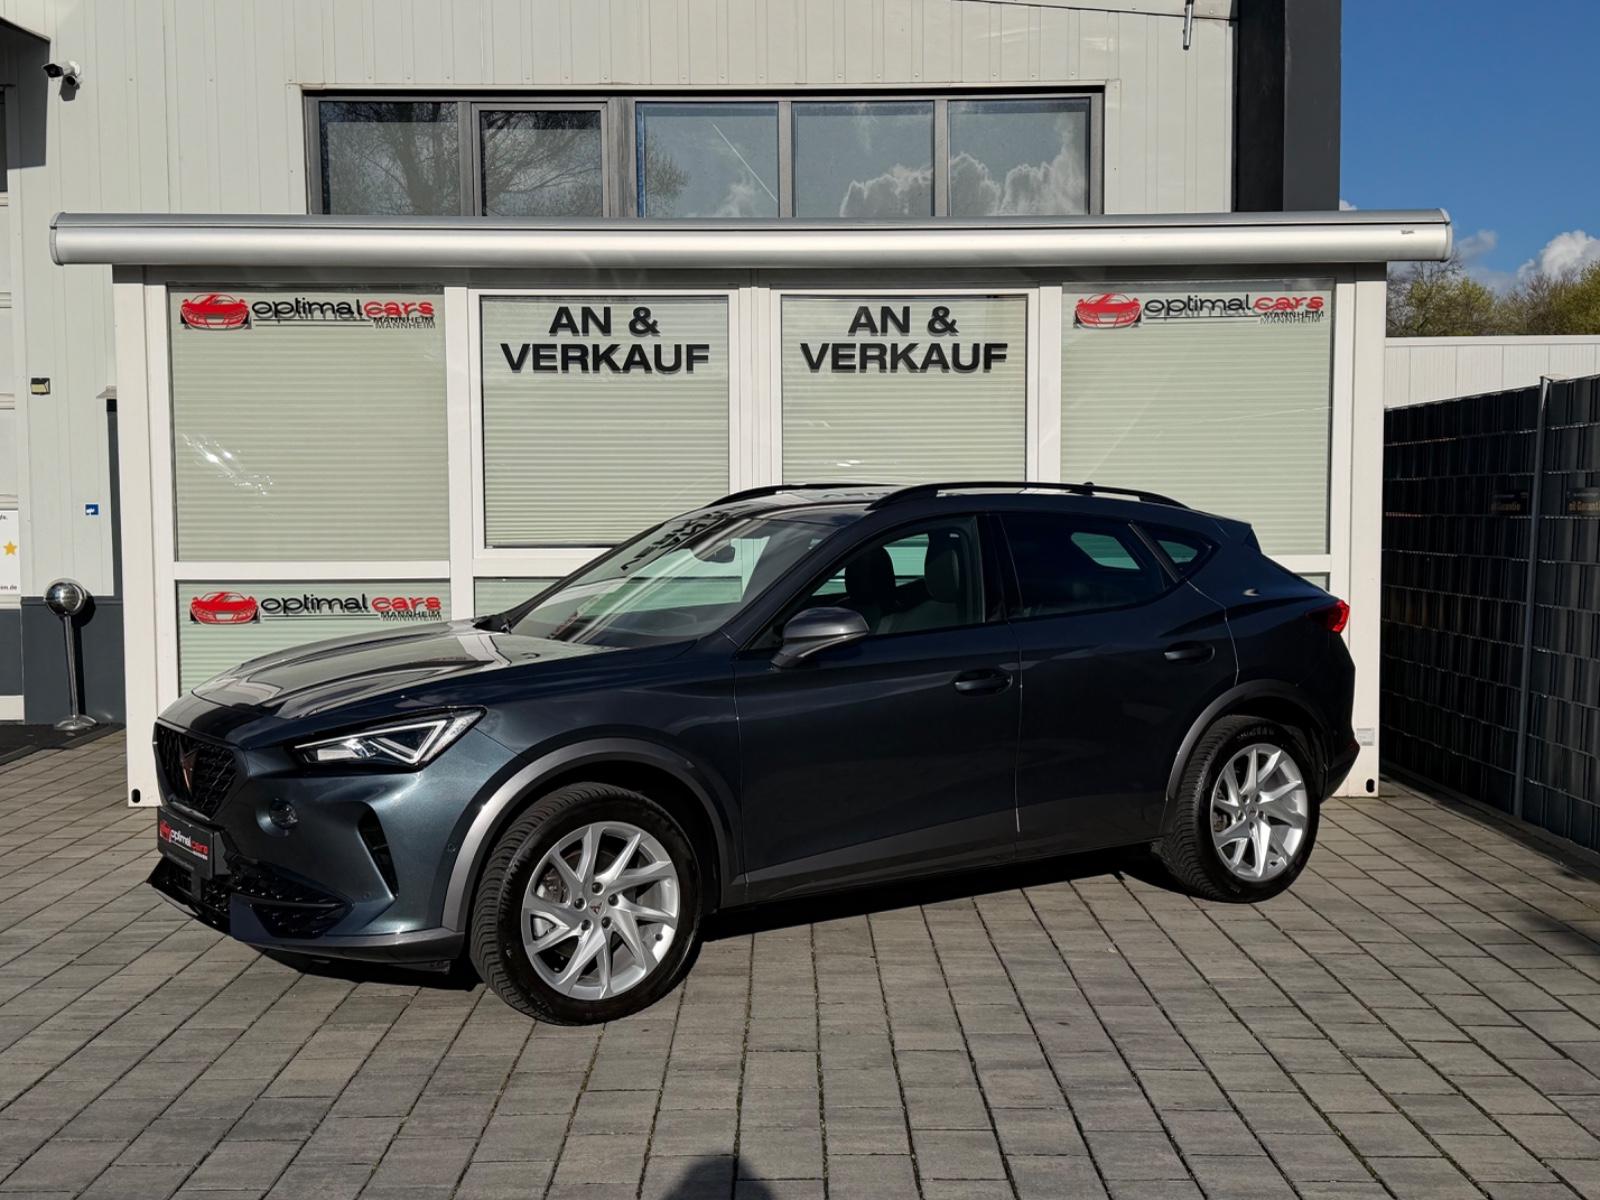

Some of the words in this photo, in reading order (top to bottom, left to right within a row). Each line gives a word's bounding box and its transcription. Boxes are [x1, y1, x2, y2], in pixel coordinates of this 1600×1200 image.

[549, 306, 612, 335] AN
[628, 306, 660, 335] &
[847, 306, 912, 335] AN
[927, 306, 959, 335] &
[500, 343, 711, 373] VERKAUF
[800, 342, 1008, 372] VERKAUF
